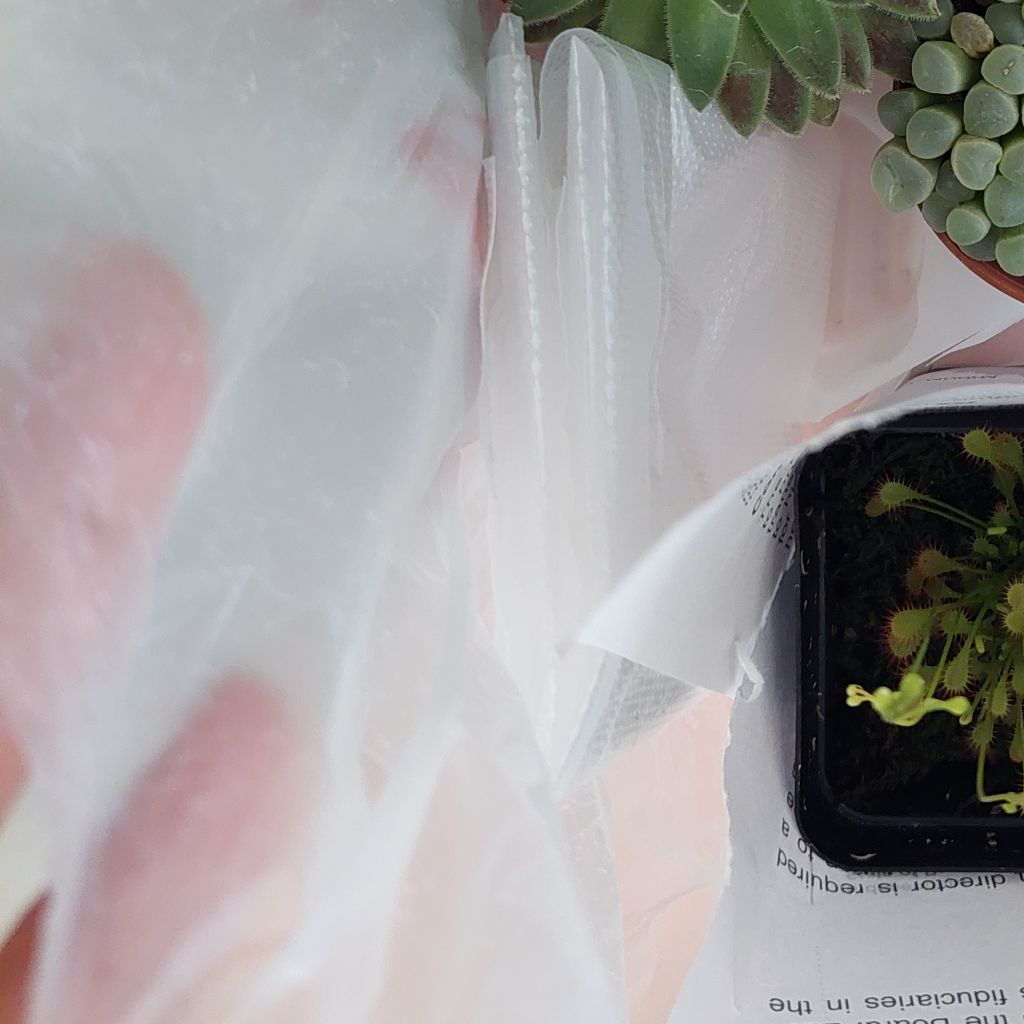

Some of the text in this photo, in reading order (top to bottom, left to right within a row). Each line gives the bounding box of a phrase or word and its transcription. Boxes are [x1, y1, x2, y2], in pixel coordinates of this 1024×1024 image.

[781, 817, 813, 862] to a
[776, 847, 864, 895] required
[877, 882, 898, 896] is
[911, 874, 1006, 893] director
[769, 998, 812, 1016] the
[827, 998, 850, 1015] in
[864, 988, 1007, 1012] fiduciaries
